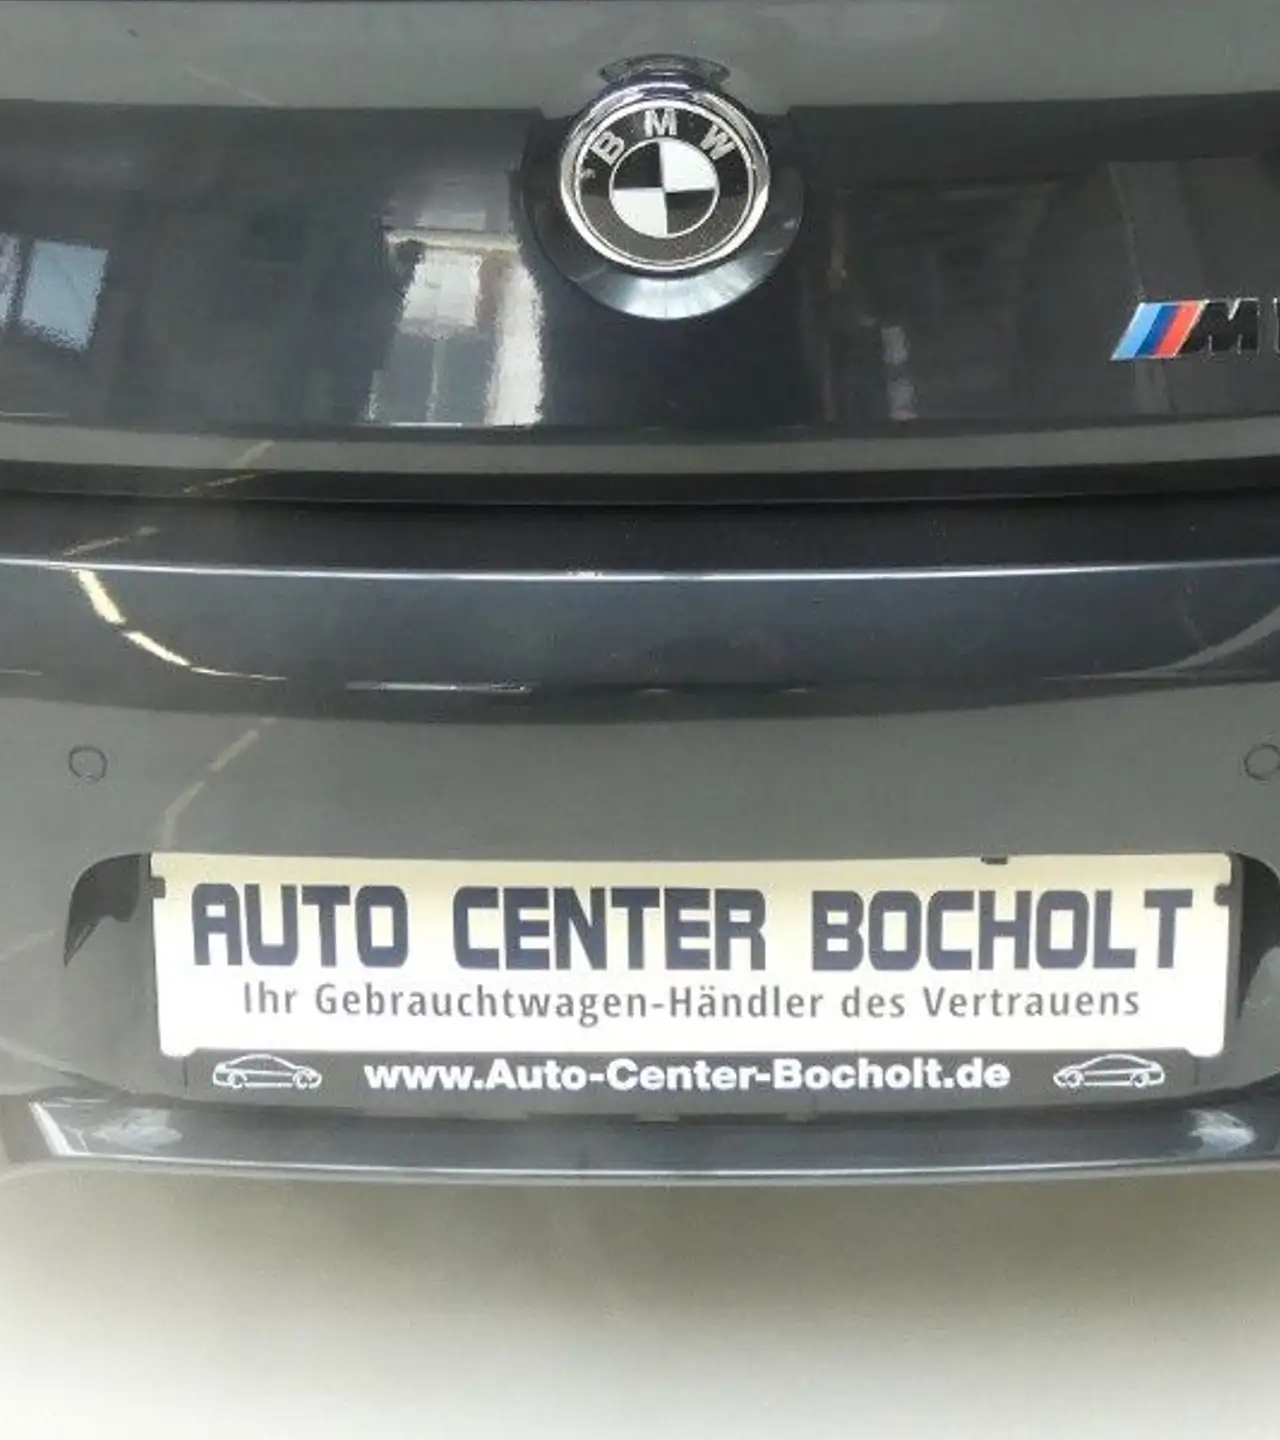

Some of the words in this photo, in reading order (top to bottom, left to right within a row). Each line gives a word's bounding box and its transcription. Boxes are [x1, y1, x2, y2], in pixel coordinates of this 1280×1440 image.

[590, 108, 736, 166] BMW
[191, 883, 409, 968] AUTO
[452, 886, 766, 971] CENTER
[812, 888, 1193, 971] BOCHOLT
[244, 981, 298, 1014] Ihr
[315, 982, 824, 1028] Gebrauchtwagen-Händler
[841, 986, 906, 1018] des
[923, 986, 1140, 1018] Vertrauens
[364, 1058, 1011, 1092] www.Auto-Center-Bocholt.de
